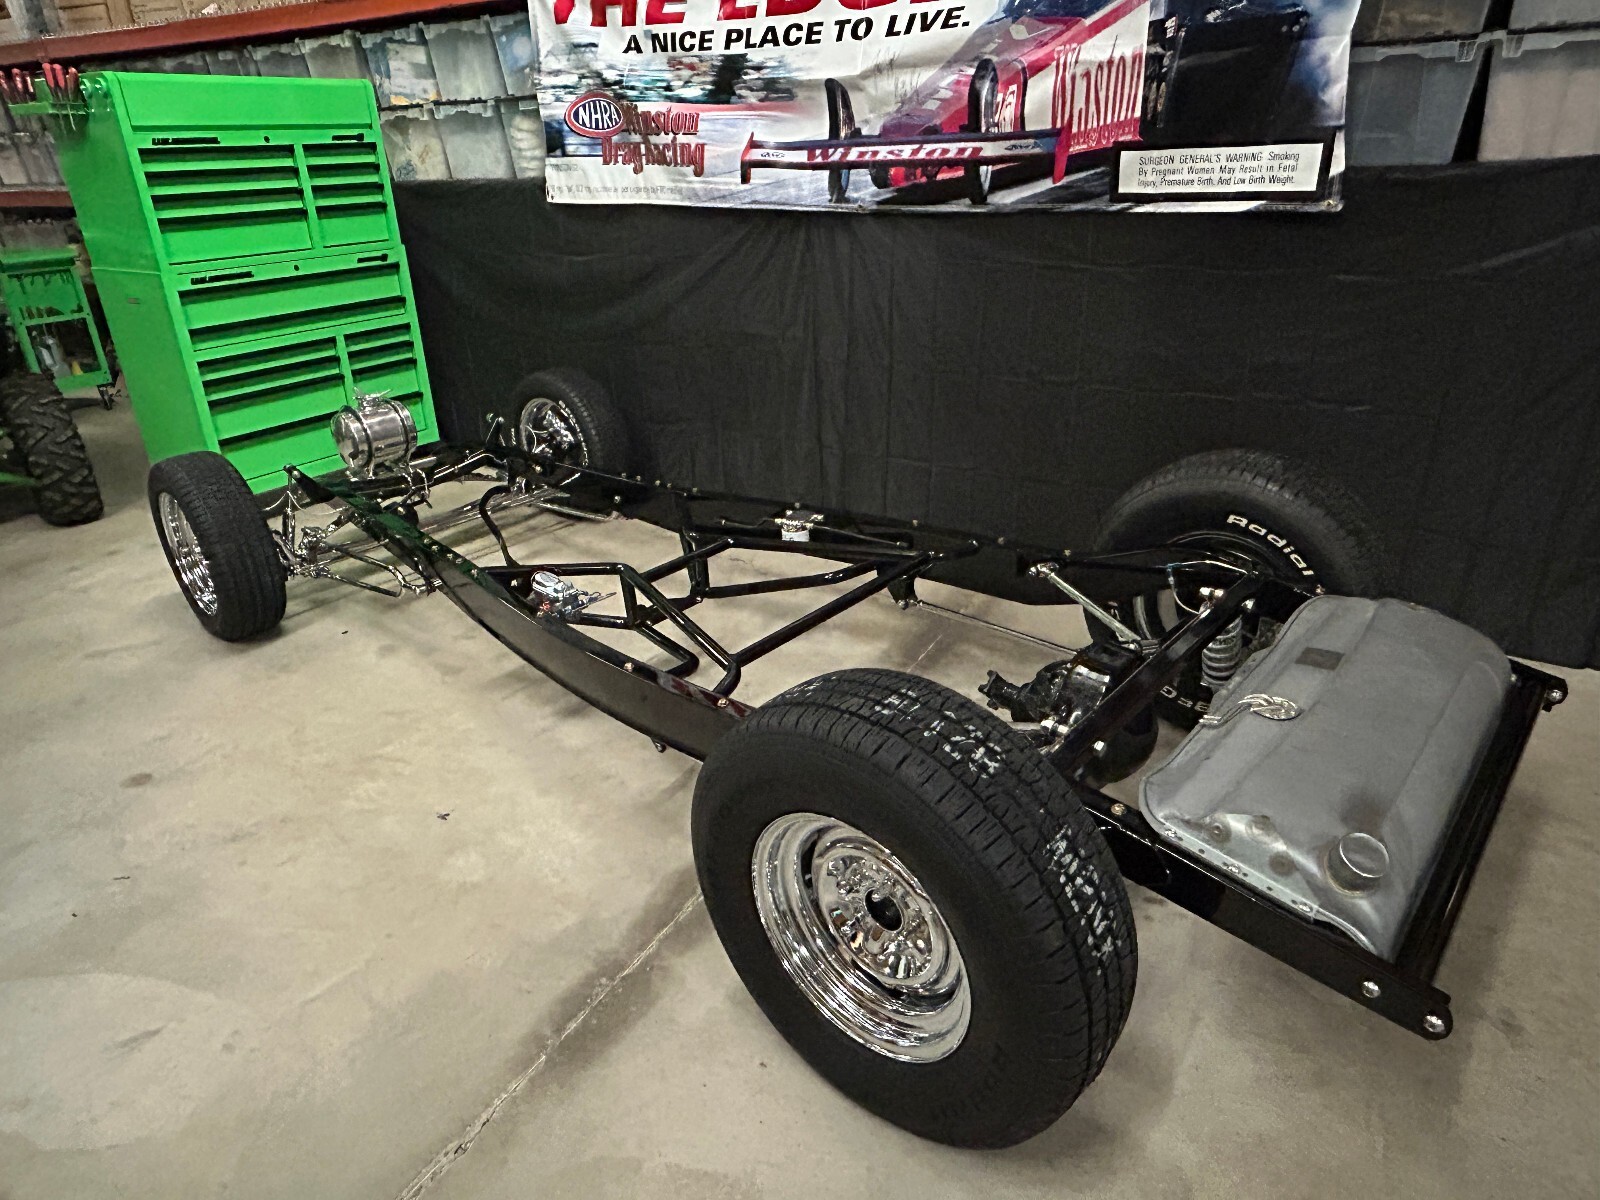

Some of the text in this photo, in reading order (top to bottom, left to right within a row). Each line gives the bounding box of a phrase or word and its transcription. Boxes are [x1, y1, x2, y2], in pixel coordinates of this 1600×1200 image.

[622, 34, 643, 54] A
[651, 30, 715, 53] NICE
[723, 21, 824, 50] PLACE
[833, 16, 874, 43] TO
[884, 6, 971, 37] LIVE.
[577, 99, 619, 130] NHRA
[620, 102, 701, 136] Winston
[601, 137, 644, 175] Drag
[1138, 167, 1149, 177] By
[1151, 167, 1184, 179] Pregnant
[1187, 165, 1215, 175] Women
[1218, 165, 1236, 176] May
[1239, 164, 1263, 174] Result
[1278, 163, 1299, 172] Fetal
[1139, 155, 1175, 166] SURGEON
[1179, 153, 1221, 165] GENERAL'S
[1268, 151, 1300, 162] Smoking
[1159, 176, 1195, 187] Premature
[1217, 175, 1232, 185] And
[1233, 175, 1246, 185] Low
[1248, 174, 1266, 185] Birth
[1226, 513, 1314, 577] Radial
